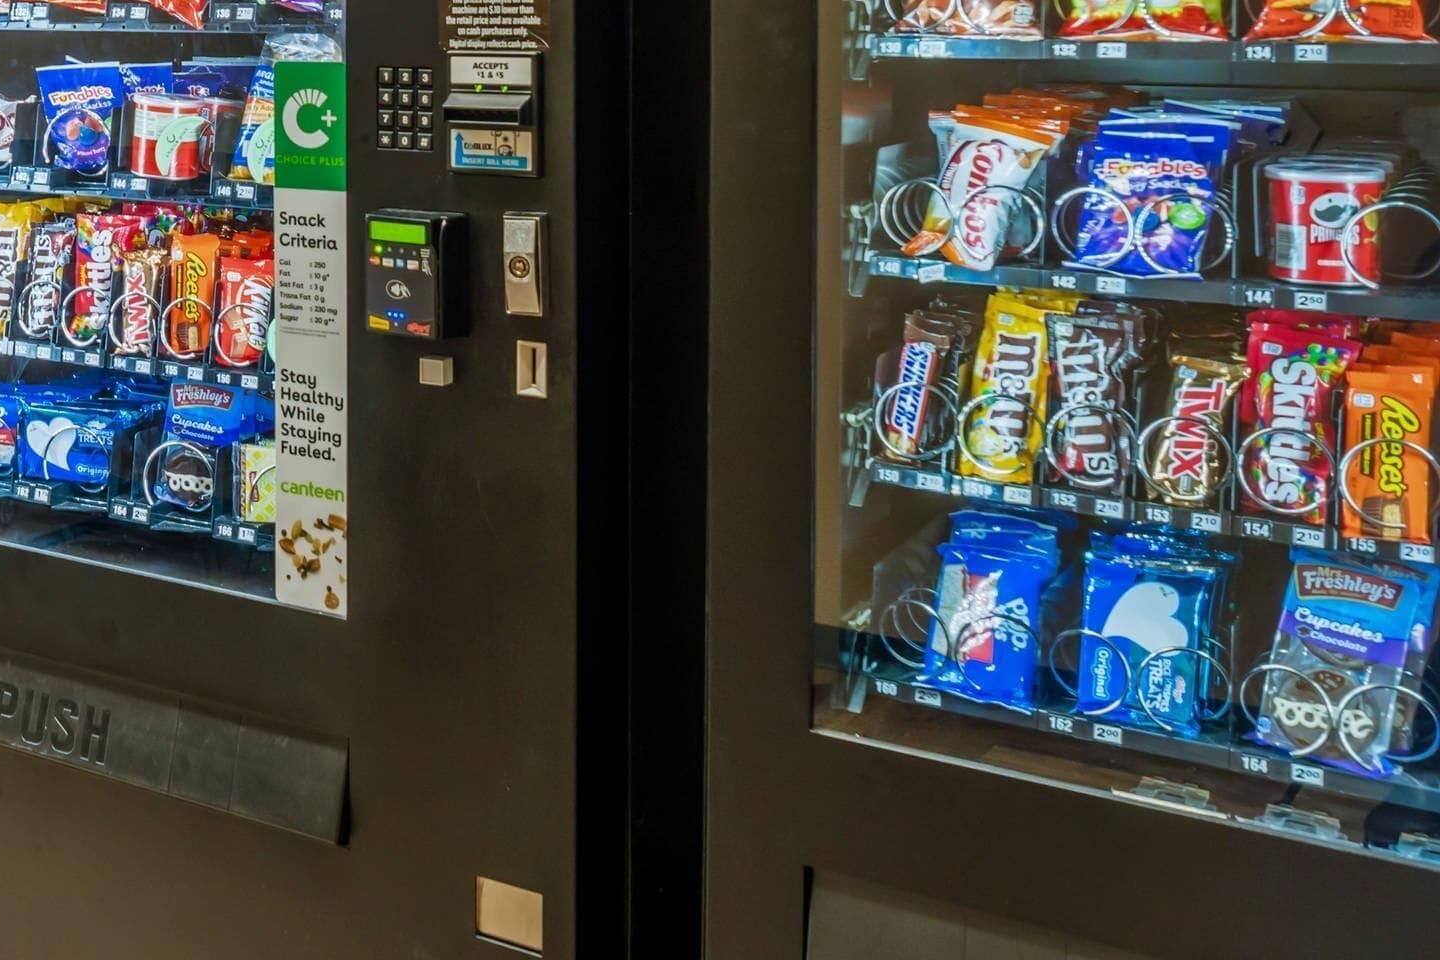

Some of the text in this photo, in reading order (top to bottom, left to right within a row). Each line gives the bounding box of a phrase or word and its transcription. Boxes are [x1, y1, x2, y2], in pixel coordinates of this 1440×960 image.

[445, 16, 456, 25] the
[473, 17, 489, 26] price
[489, 16, 502, 25] and
[1052, 43, 1077, 56] 132
[1245, 46, 1272, 60] 134
[472, 62, 509, 70] ACCEPTS
[383, 72, 428, 82] 1 2 3
[49, 85, 113, 107] Funables
[382, 93, 428, 104] 4 5 6
[383, 114, 428, 125] 7 8 9
[401, 136, 408, 146] 0
[276, 153, 344, 167] CHOICE PLUS
[462, 157, 520, 166] INSERT BILL HERE
[1103, 158, 1208, 178] Funables
[112, 178, 127, 190] 144
[279, 211, 326, 228] Snack
[279, 232, 338, 251] Criteria
[279, 258, 326, 269] Cal 250
[279, 269, 291, 277] Fat
[185, 251, 208, 322] Reese's
[280, 280, 291, 288] Sat
[292, 281, 304, 289] Fat
[320, 285, 324, 293] g
[1051, 275, 1076, 289] 142
[280, 291, 298, 300] Trans
[300, 293, 311, 301] Fat
[320, 296, 325, 304] g
[1245, 290, 1272, 304] 144
[126, 271, 151, 345] TWIX
[280, 302, 338, 316] Sodium 230 mg
[280, 313, 322, 324] Sugar 20
[280, 368, 317, 389] Stay
[175, 388, 231, 405] Freshley's
[280, 387, 344, 411] Healthy
[280, 404, 325, 423] While
[171, 413, 225, 435] Cupcakes
[1170, 378, 1225, 480] TWIX
[181, 429, 215, 441] Chocolate
[280, 422, 342, 447] Staying
[280, 441, 336, 462] Fueled.
[1378, 395, 1421, 498] Reese's
[877, 469, 899, 482] 150
[280, 480, 345, 503] canteen
[1052, 493, 1077, 507] 152
[1146, 507, 1170, 522] 153
[1244, 521, 1270, 536] 154
[1349, 539, 1376, 553] 155
[1302, 569, 1396, 601] Freshley's
[1293, 606, 1385, 644] Cupcakes
[1309, 629, 1368, 653] Chocolate
[1094, 648, 1109, 699] Original
[1146, 658, 1163, 710] TREATS
[1049, 716, 1073, 731] 162
[1241, 755, 1268, 774] 164
